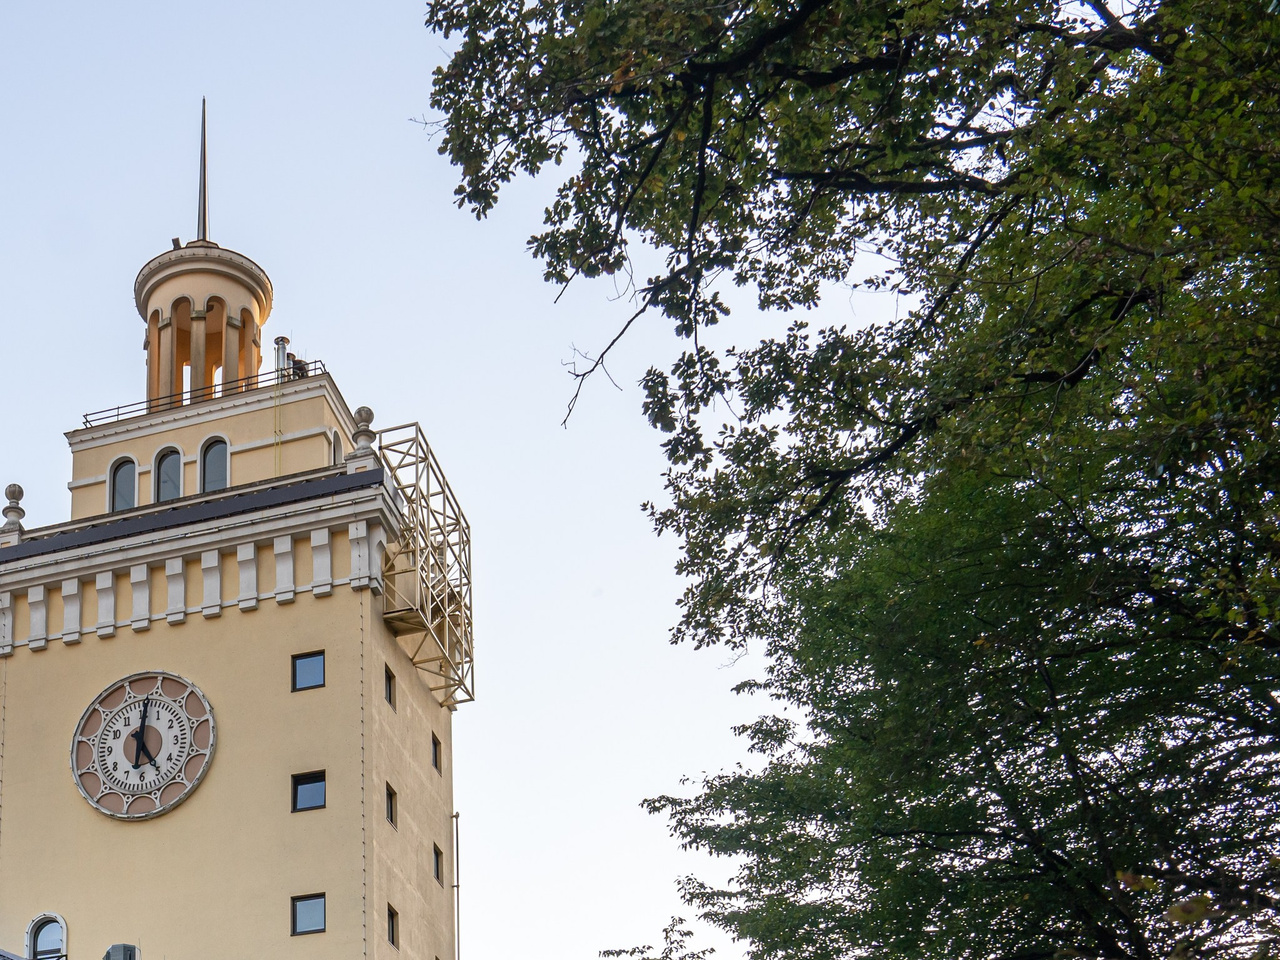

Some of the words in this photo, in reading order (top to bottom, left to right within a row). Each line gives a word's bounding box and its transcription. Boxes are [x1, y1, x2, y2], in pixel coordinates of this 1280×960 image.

[156, 711, 160, 720] 1
[124, 717, 130, 726] 11
[168, 719, 174, 729] 2
[113, 729, 121, 739] 10
[173, 735, 179, 745] 3
[107, 746, 113, 756] 9
[167, 753, 173, 762] 4
[113, 762, 118, 771] 8
[155, 766, 160, 776] 5
[124, 771, 130, 780] 7
[139, 772, 145, 782] 6
